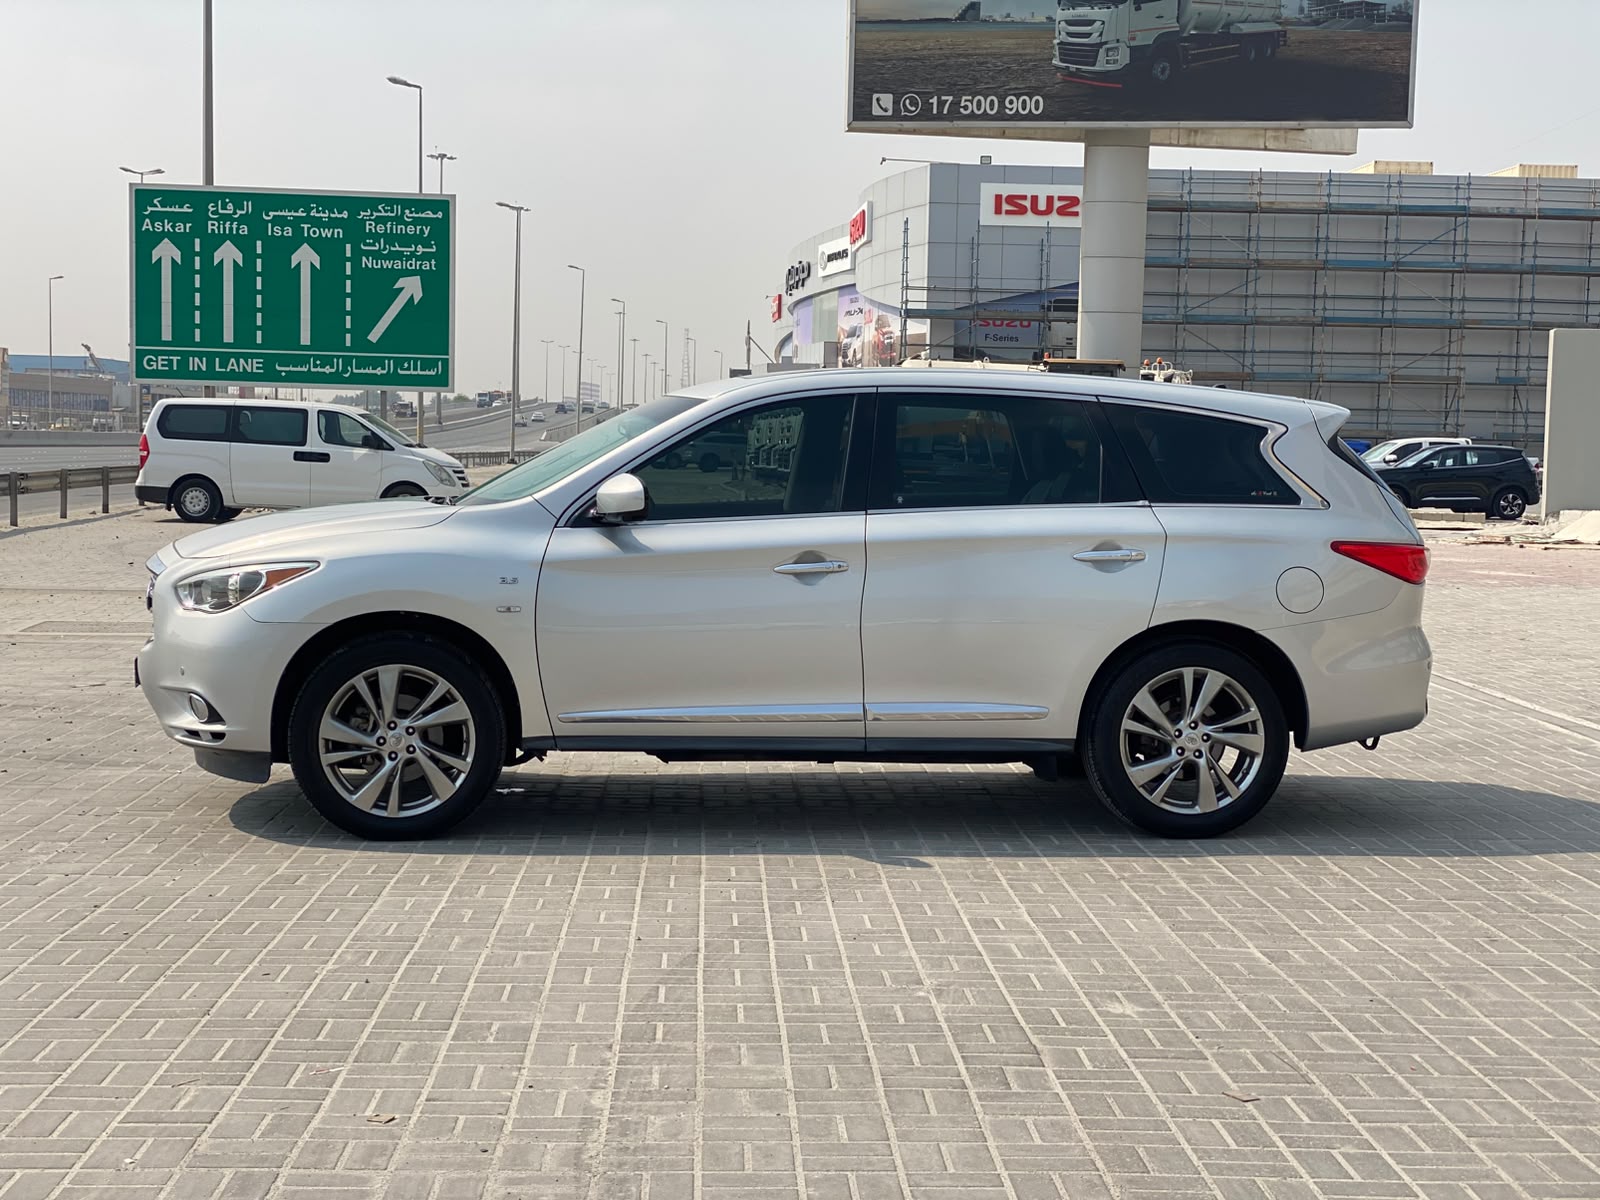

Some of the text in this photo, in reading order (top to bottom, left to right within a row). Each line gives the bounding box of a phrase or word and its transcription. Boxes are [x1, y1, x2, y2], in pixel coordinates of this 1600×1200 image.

[929, 95, 1044, 115] 17 500 900
[142, 197, 194, 215] عسكر
[207, 198, 252, 218] الرفاع
[262, 203, 349, 221] مدينة عيسى
[356, 203, 443, 221] مصنع التكرير
[994, 193, 1081, 217] ISUZ
[141, 218, 192, 232] Askar
[207, 220, 248, 234] Riffa
[267, 222, 343, 238] Isa Town
[365, 221, 431, 237] Refinery
[360, 237, 437, 255] نويدرات
[361, 255, 437, 270] Nuwaidrat
[984, 333, 1019, 342] F-Series
[143, 355, 264, 373] GET IN LANE
[275, 356, 443, 377] اسلك المسار المناسب
